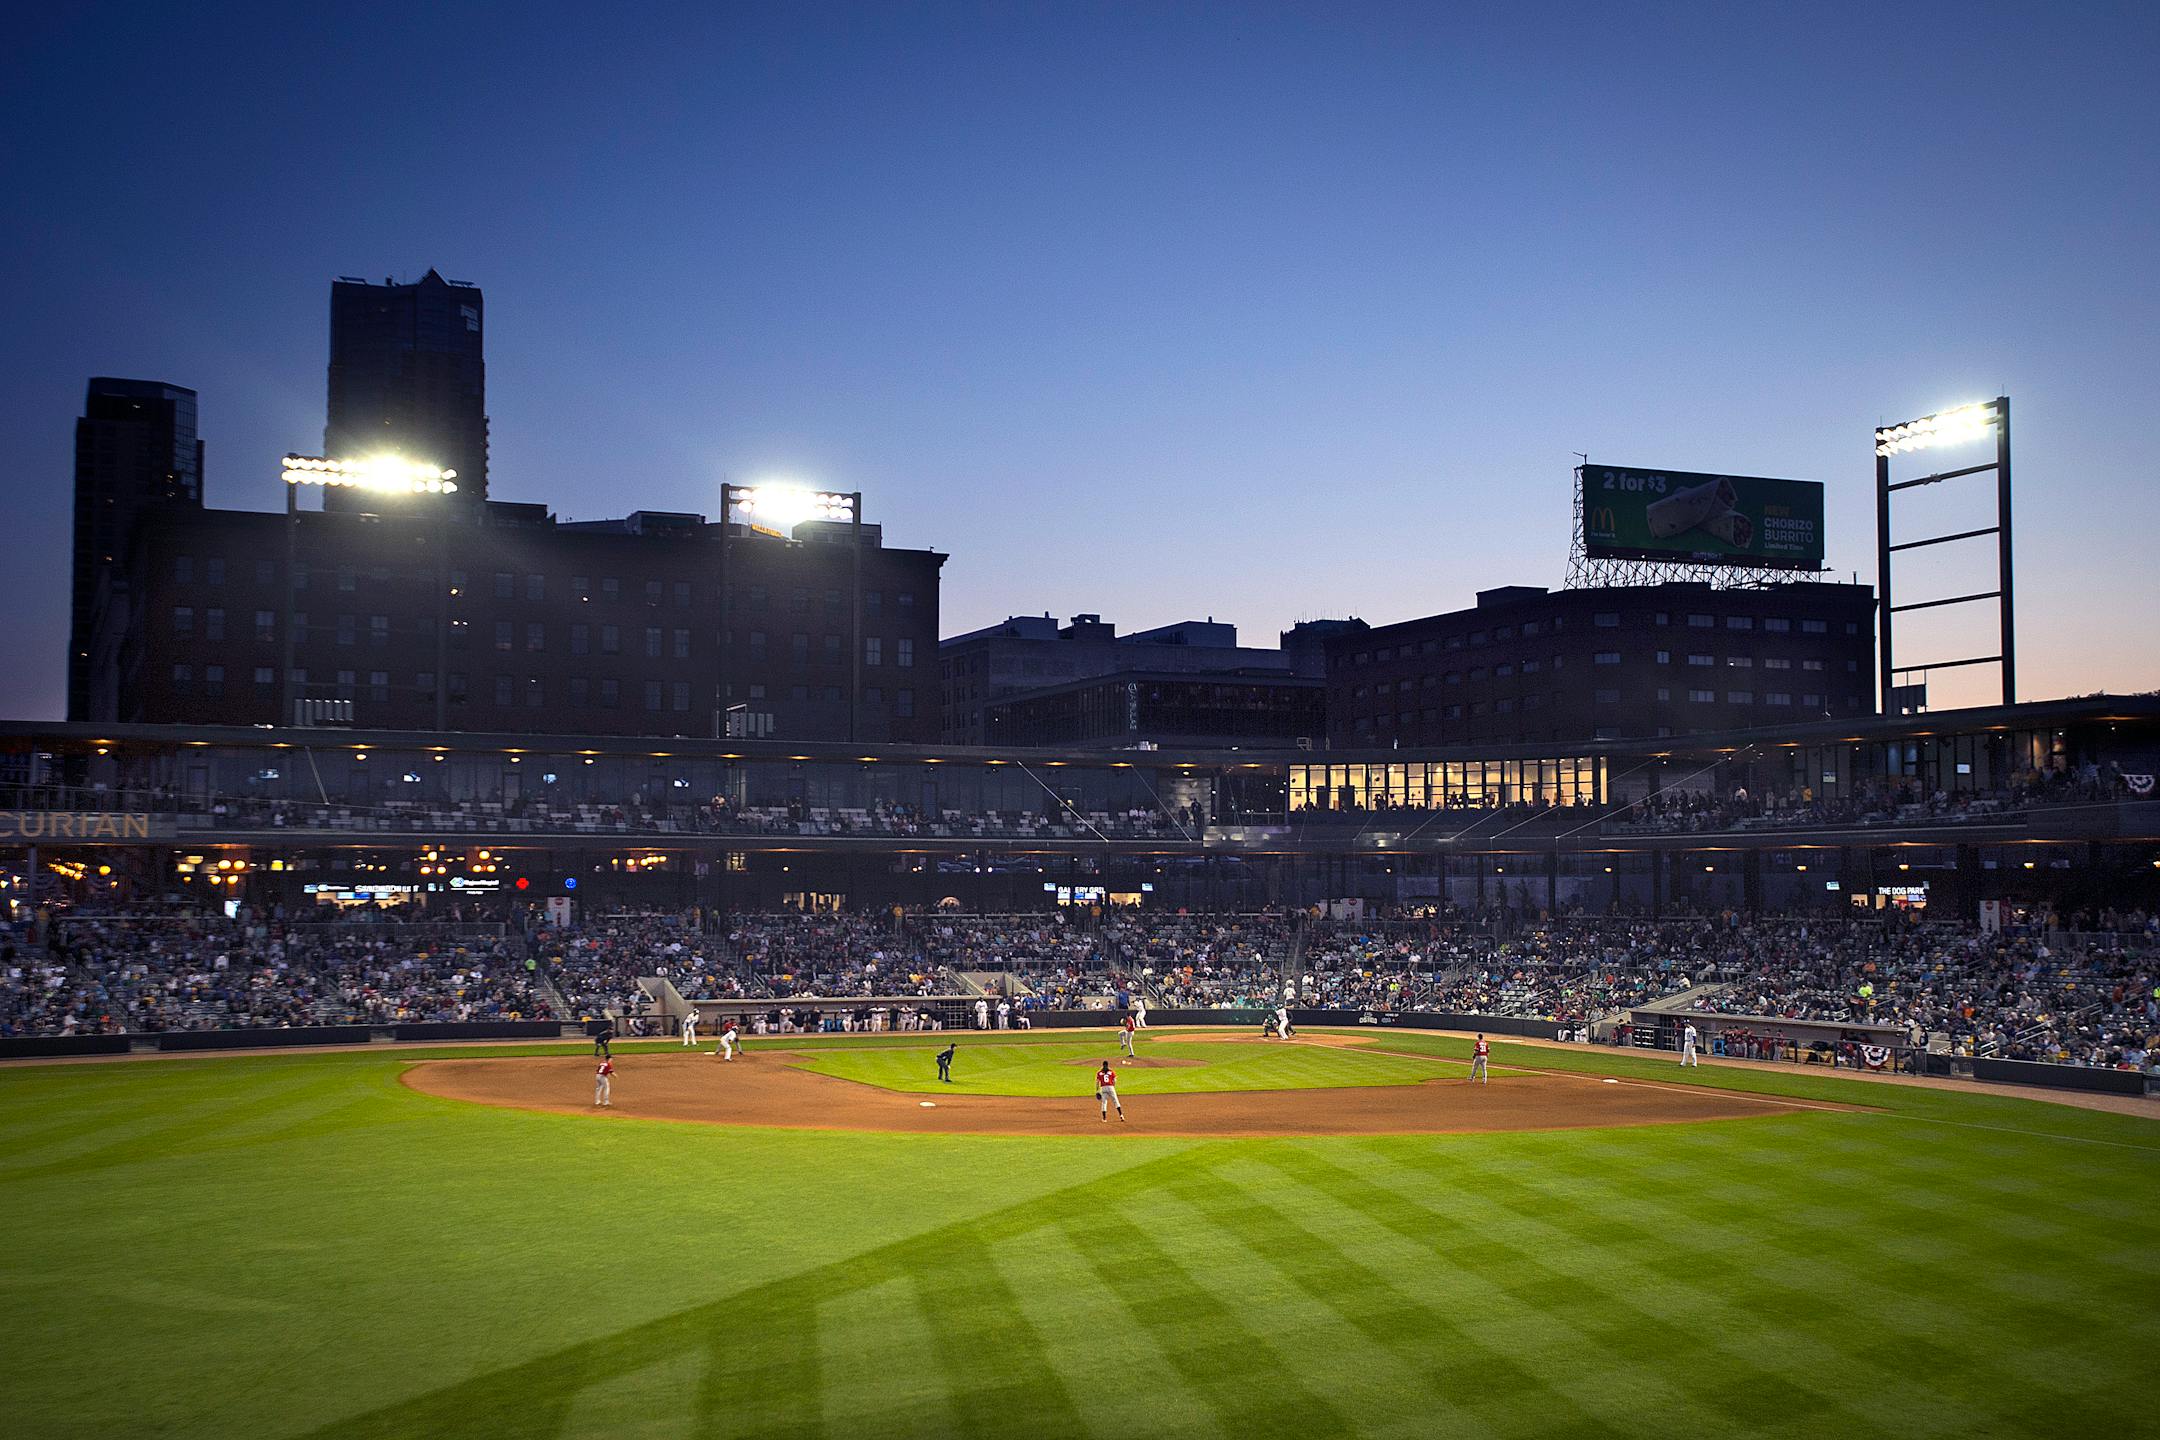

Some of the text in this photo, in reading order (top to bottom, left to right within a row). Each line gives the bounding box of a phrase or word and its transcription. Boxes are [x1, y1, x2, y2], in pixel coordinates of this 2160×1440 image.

[1603, 471, 1667, 494] 2 for $3
[1764, 517, 1814, 531] CHORIZO
[1764, 529, 1814, 543] BURRITO
[1878, 887, 1924, 895] THE DOG PARK
[1103, 1074, 1109, 1083] 6
